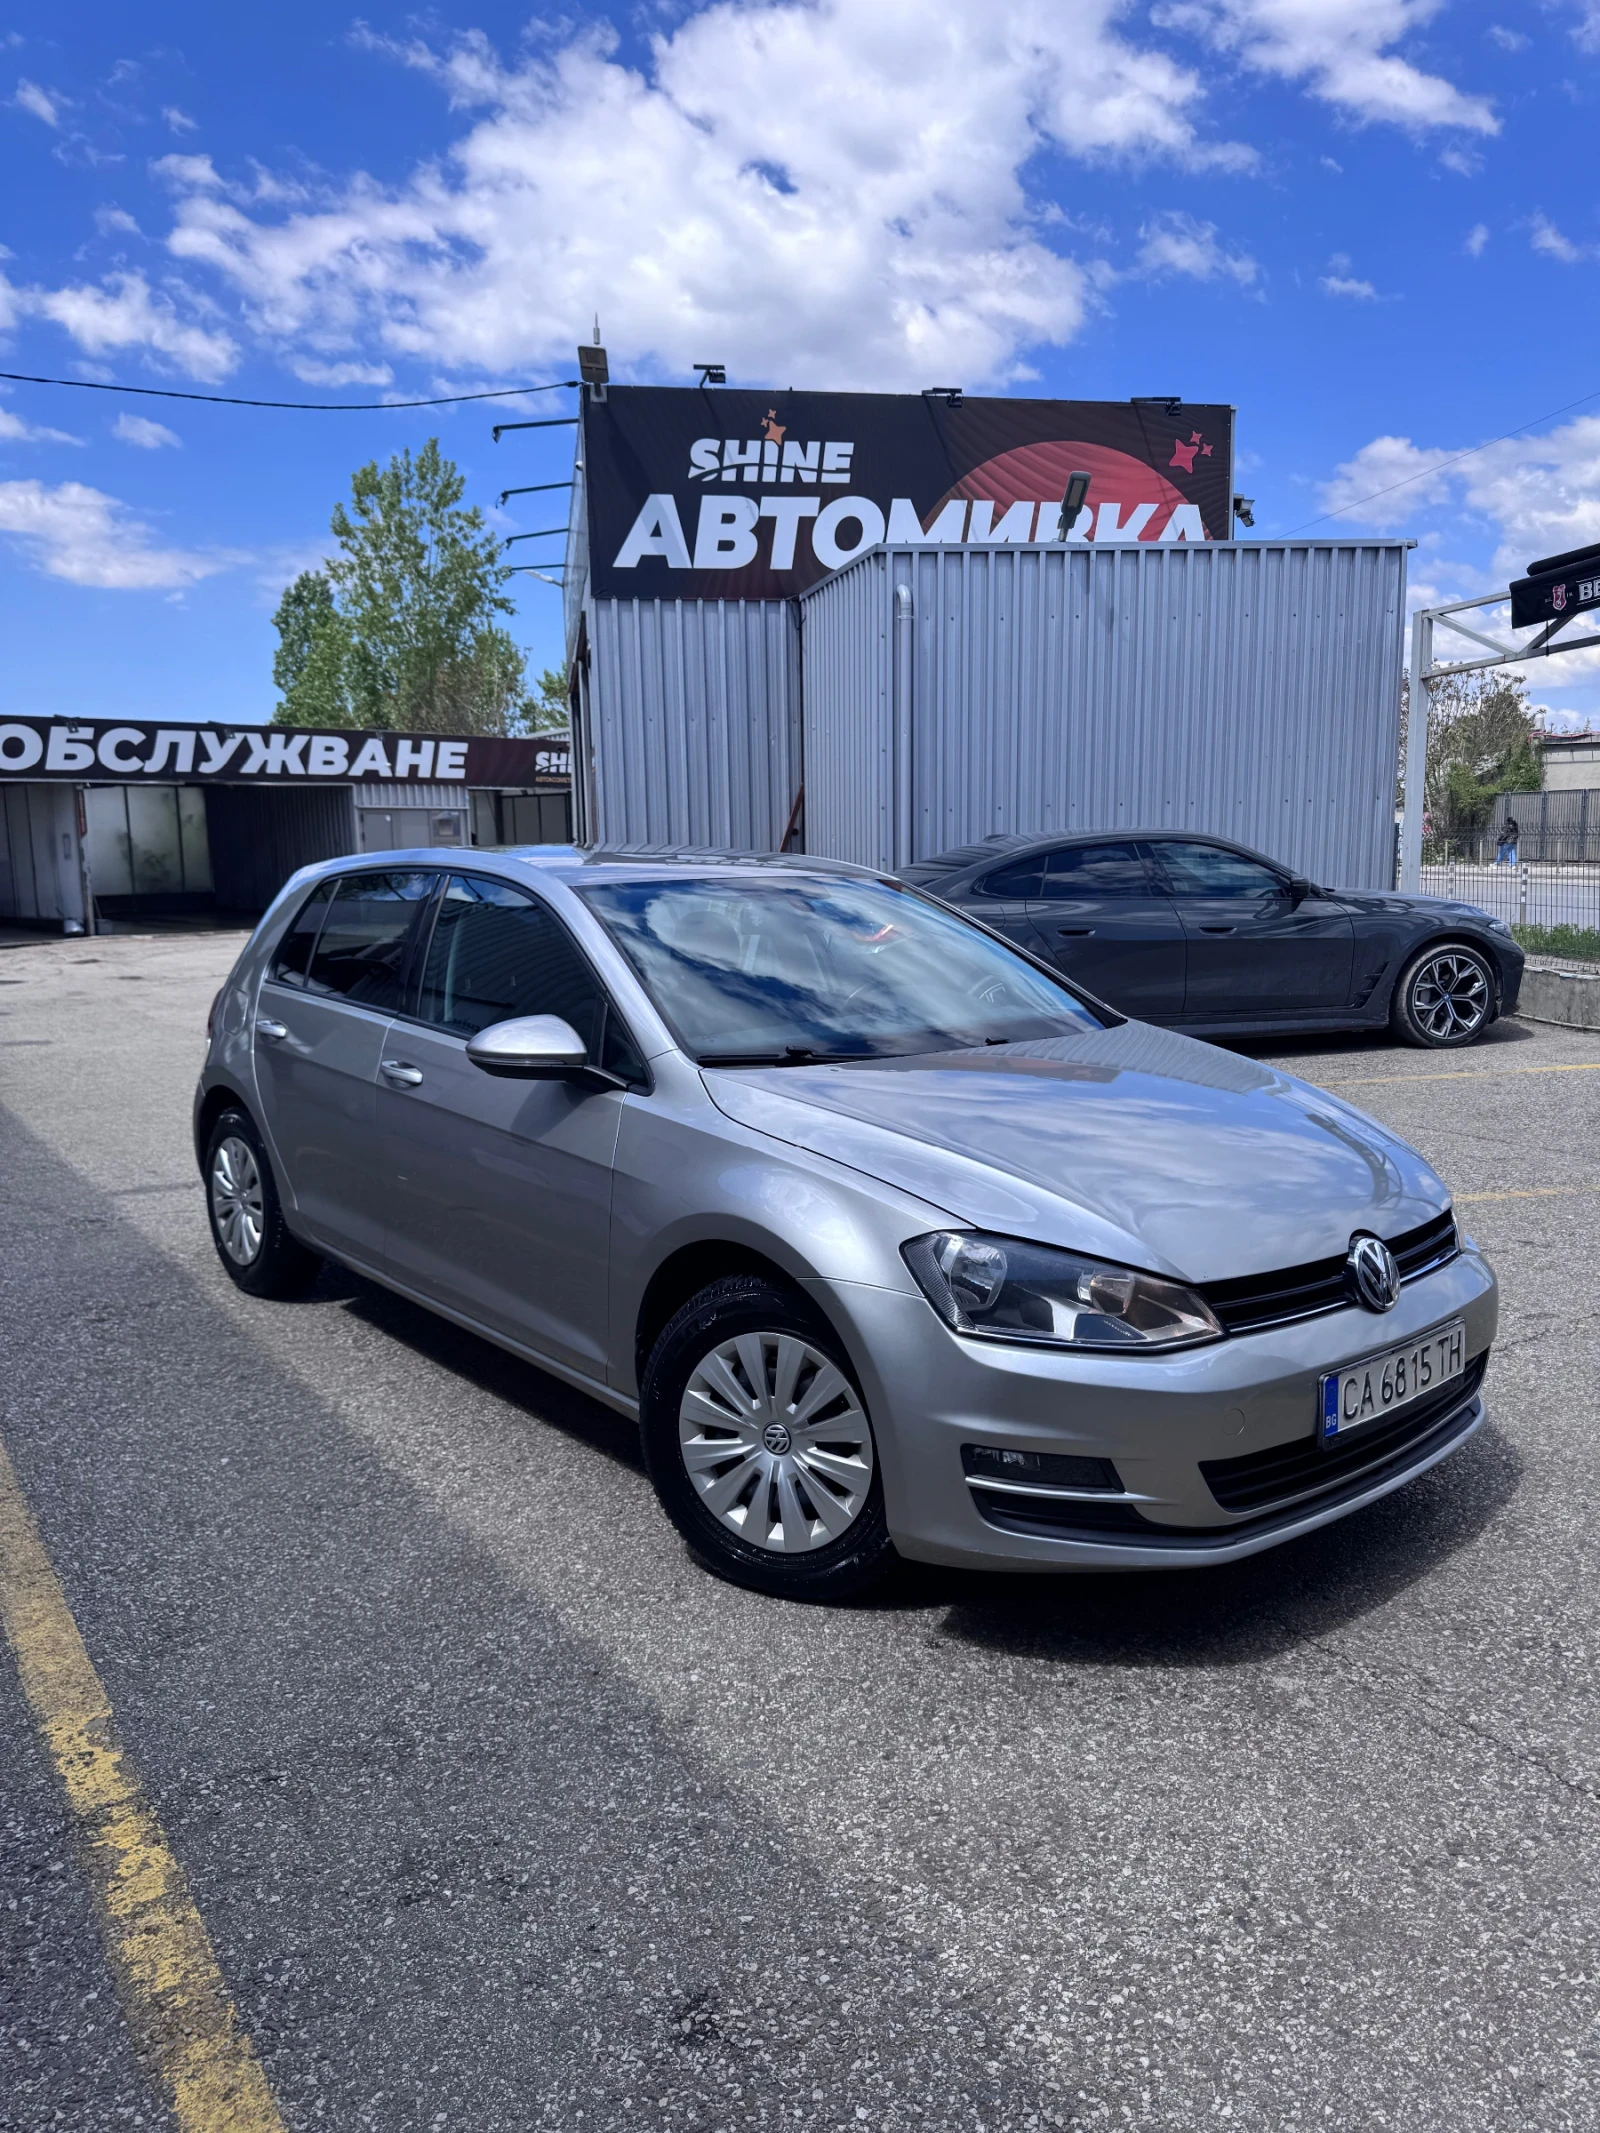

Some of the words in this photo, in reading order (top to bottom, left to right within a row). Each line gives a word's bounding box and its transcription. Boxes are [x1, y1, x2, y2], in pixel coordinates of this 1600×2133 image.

[688, 438, 855, 483] SHINE
[0, 723, 468, 779] ОБСЛУЖВАНЕ
[1342, 1371, 1375, 1421] CA
[1380, 1345, 1432, 1406] 6815
[1437, 1329, 1462, 1378] TH
[1326, 1414, 1337, 1428] BG
